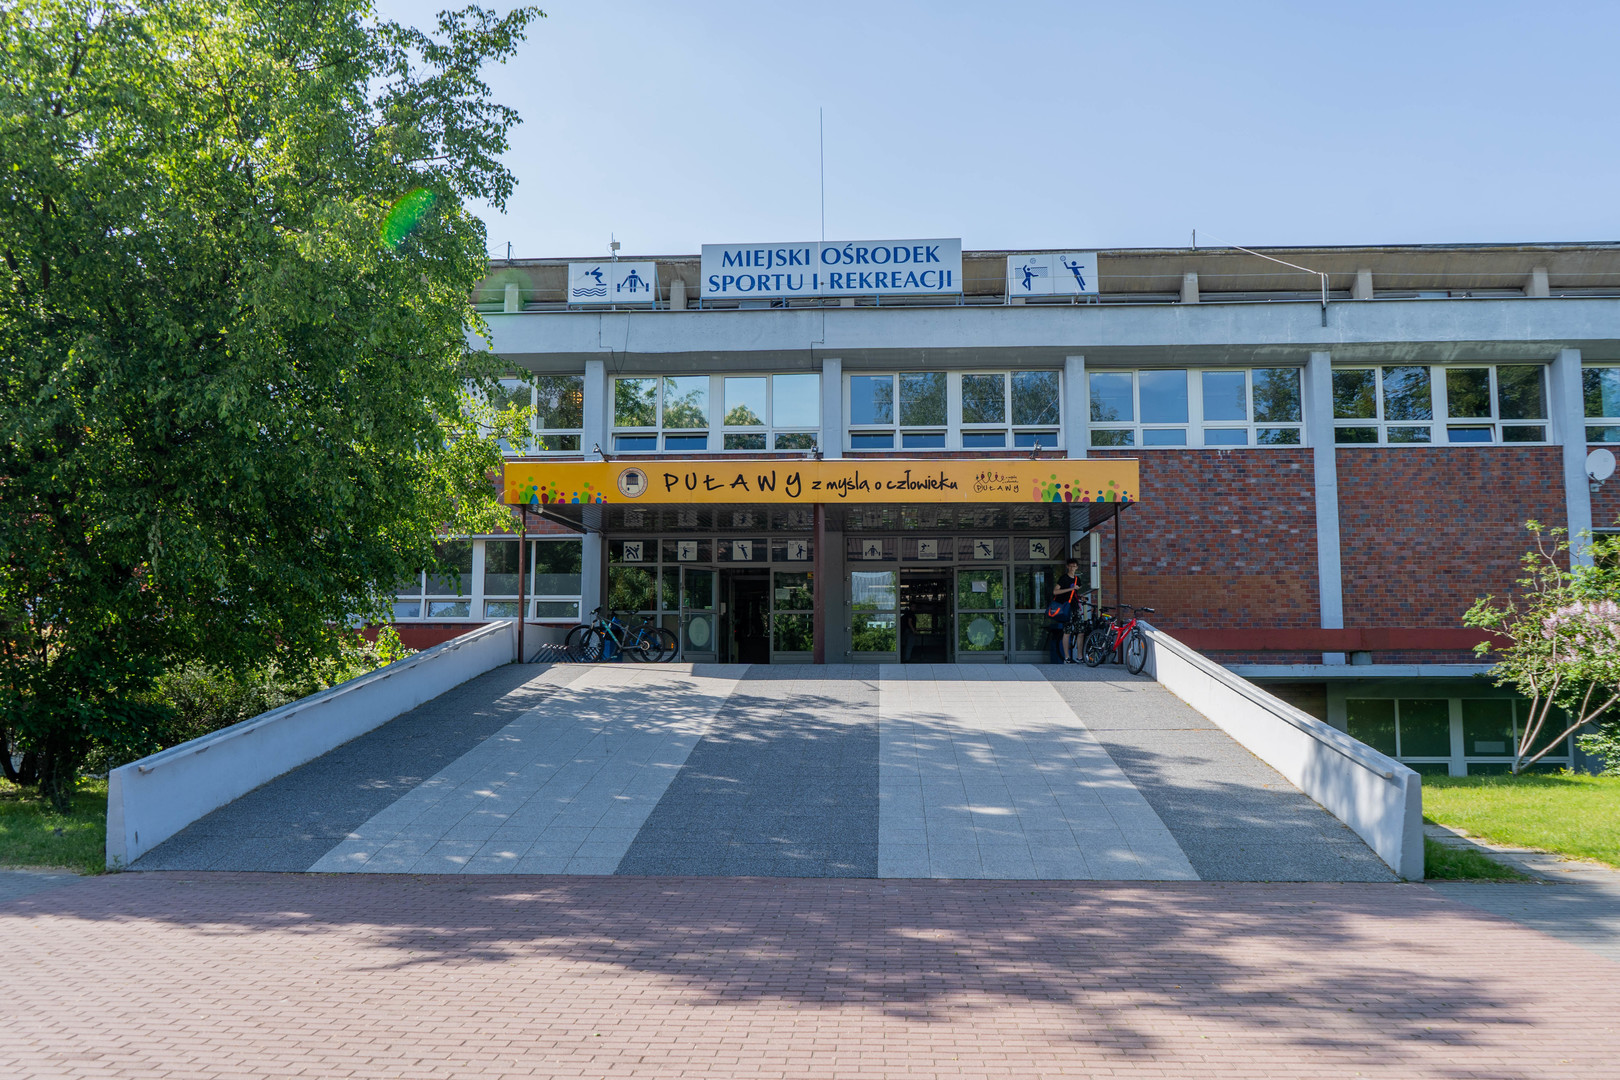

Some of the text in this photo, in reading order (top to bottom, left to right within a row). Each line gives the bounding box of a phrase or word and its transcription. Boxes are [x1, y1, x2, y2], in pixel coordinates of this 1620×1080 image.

[722, 243, 940, 270] MIEJSKI OŚRODEK
[708, 270, 952, 292] SPORTU I REKREACJI
[663, 470, 802, 498] PUŁAWY
[811, 479, 822, 491] z
[826, 470, 870, 498] myślą
[874, 481, 882, 490] o
[886, 469, 958, 491] człowieku
[976, 484, 1020, 493] PUŁAWY
